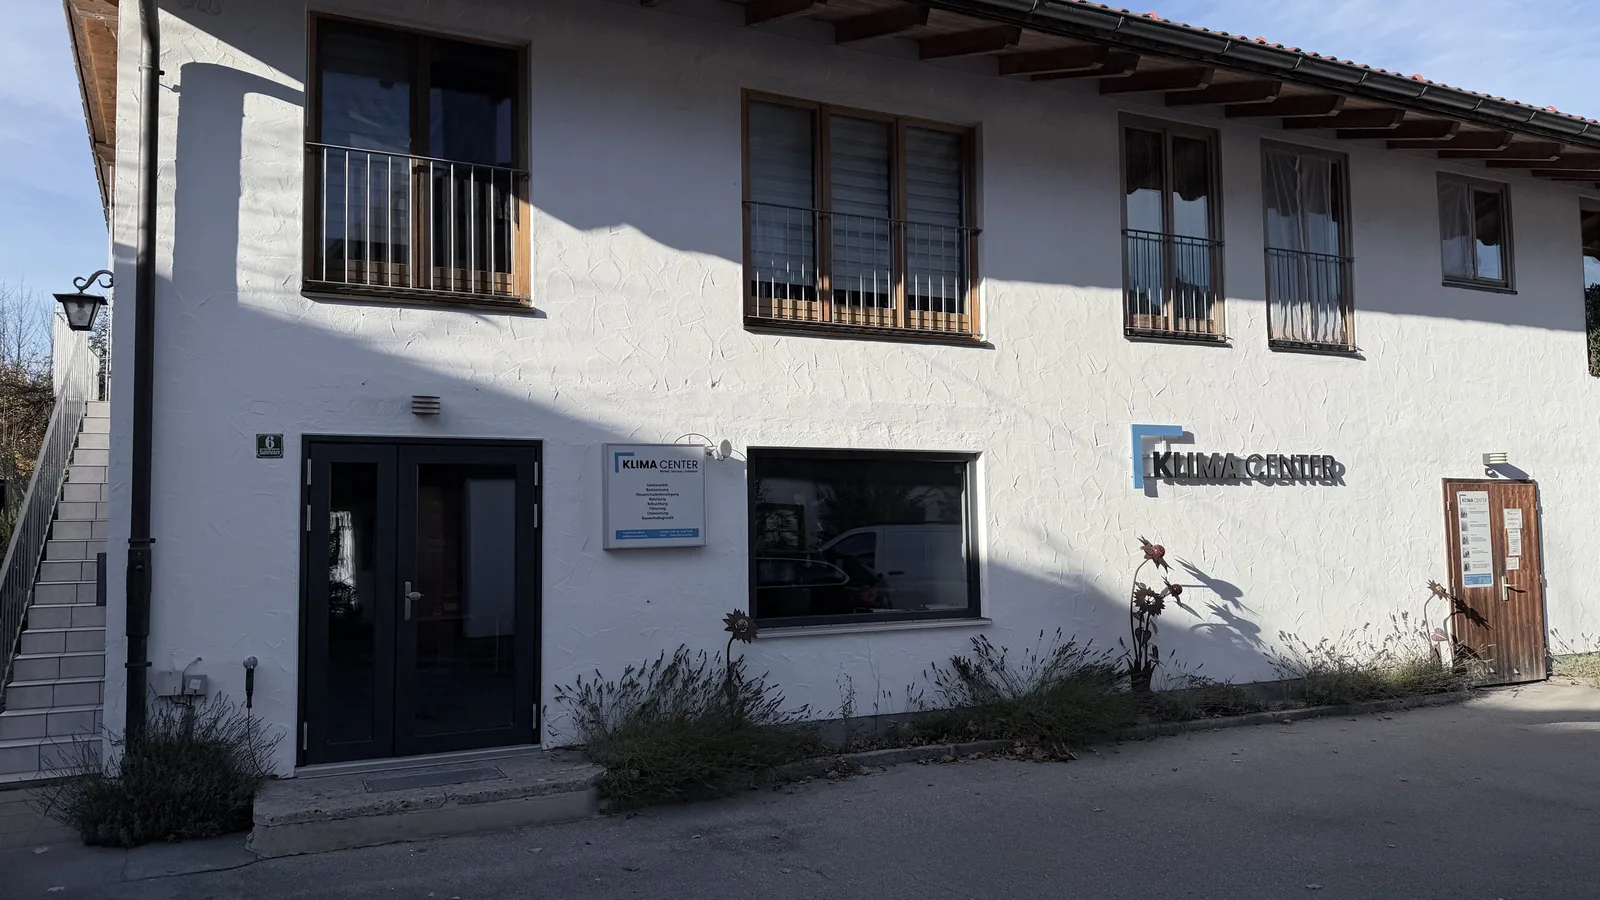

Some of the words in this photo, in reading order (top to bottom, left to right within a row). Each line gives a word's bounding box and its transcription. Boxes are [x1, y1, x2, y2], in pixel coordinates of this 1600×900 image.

[265, 435, 275, 449] 6
[622, 460, 657, 469] KLIMA
[659, 460, 698, 469] CENTER
[1153, 451, 1237, 478] KLIMA
[1246, 453, 1335, 479] CENTER
